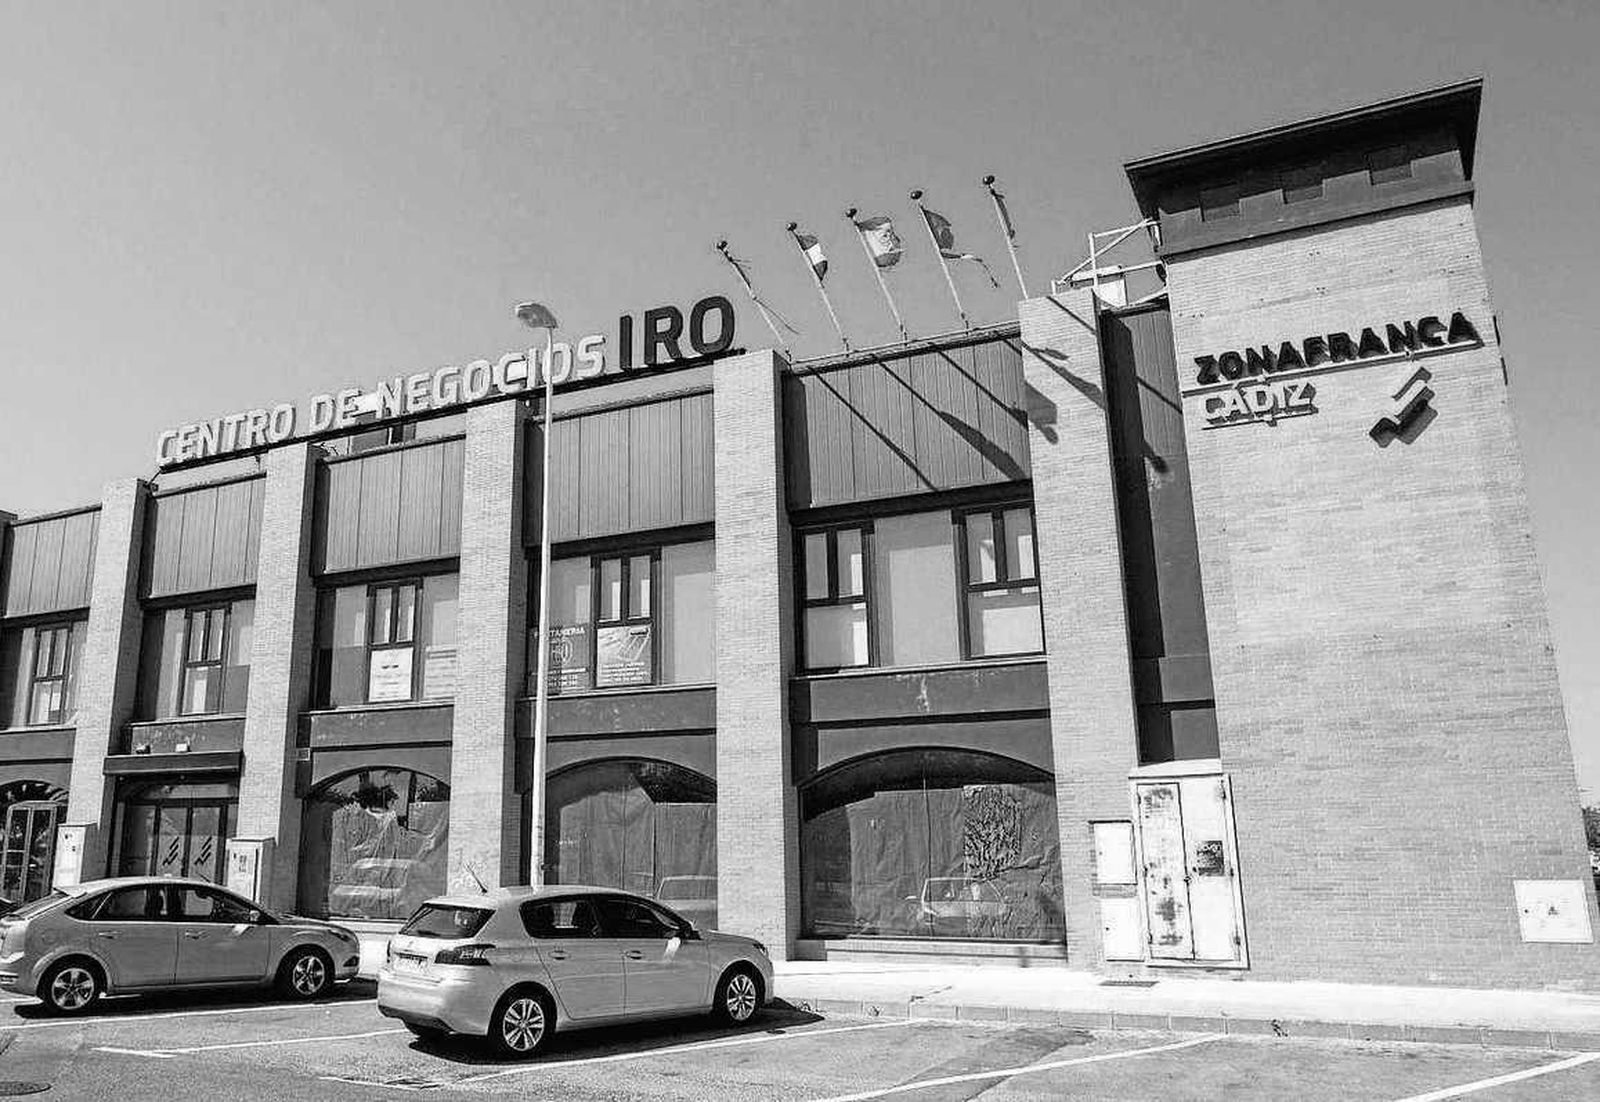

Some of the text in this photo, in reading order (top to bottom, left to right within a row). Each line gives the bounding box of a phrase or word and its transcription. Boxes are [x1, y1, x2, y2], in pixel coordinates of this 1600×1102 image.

[156, 296, 735, 464] CENTRO DE NEGOCIOS IRO
